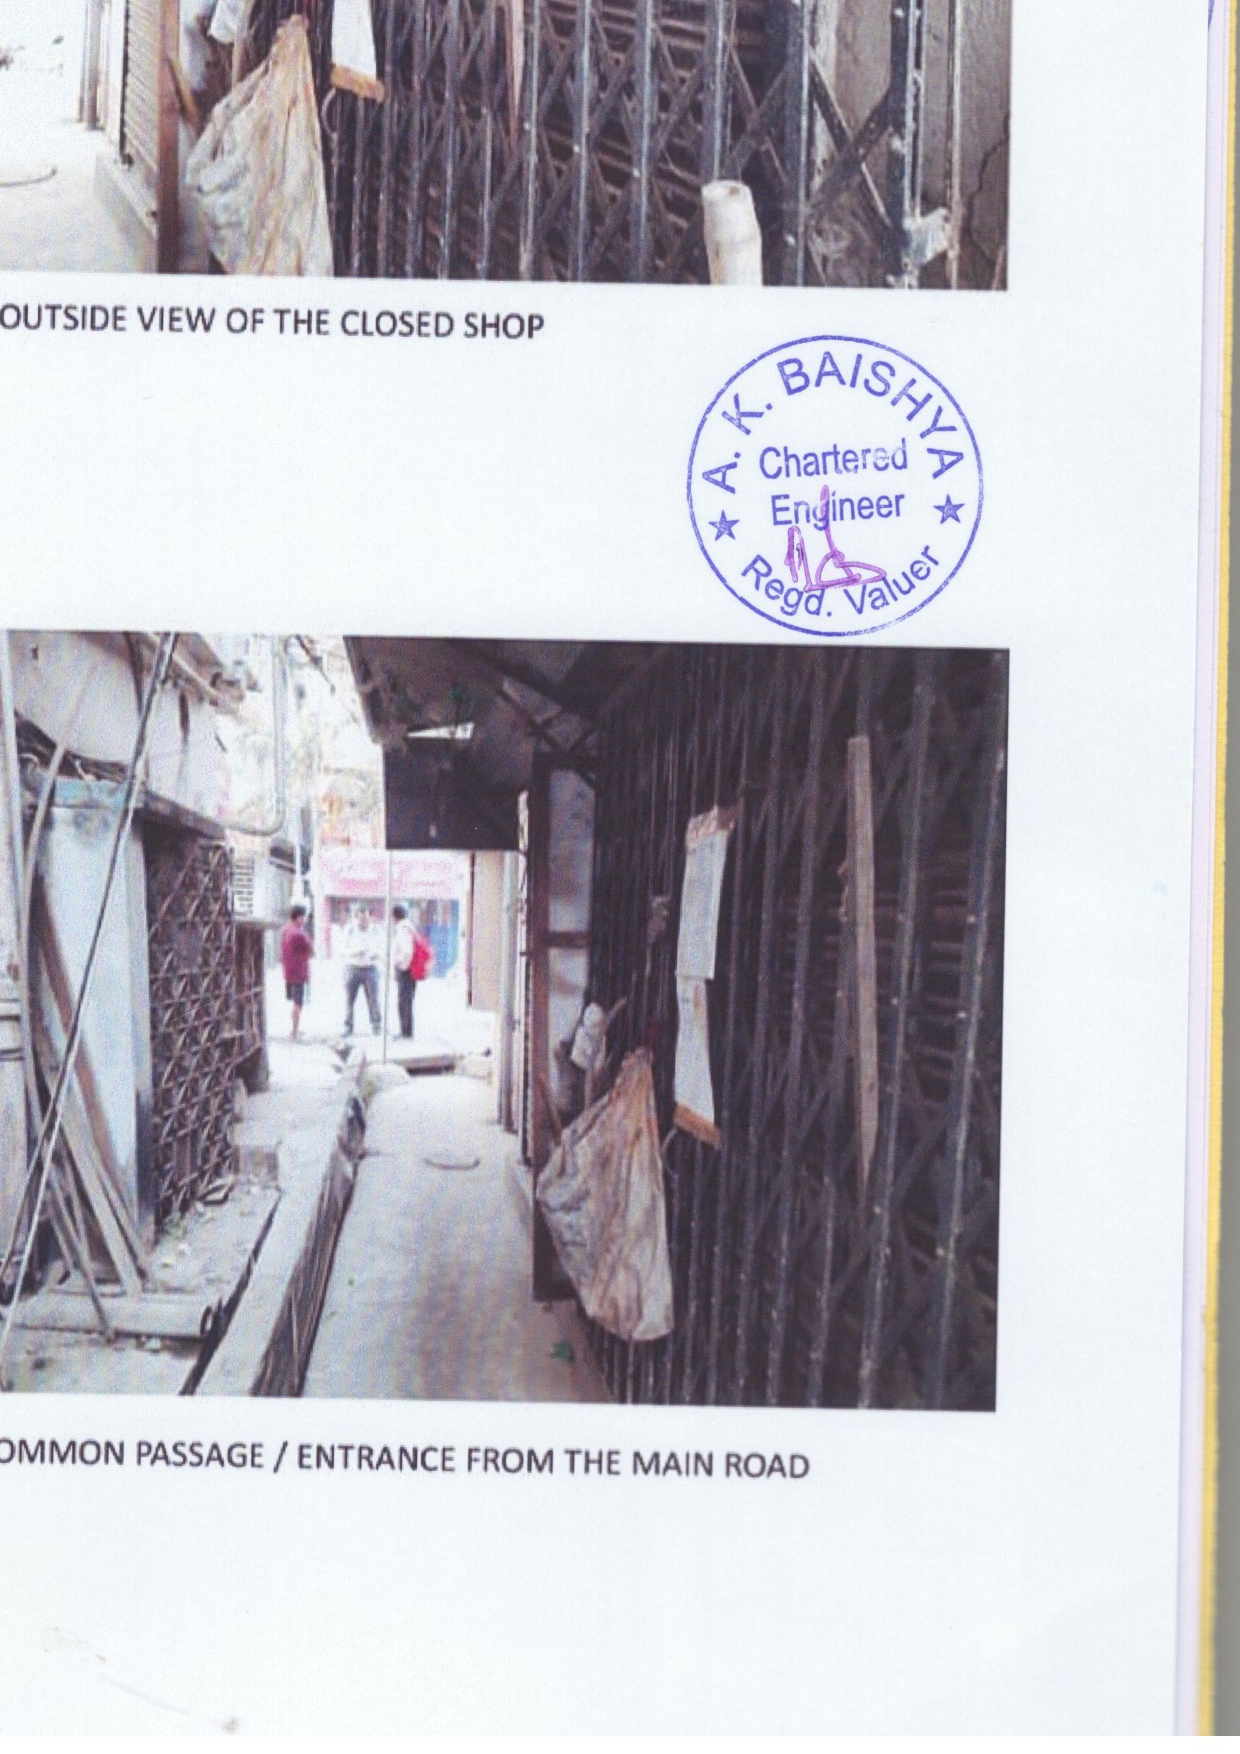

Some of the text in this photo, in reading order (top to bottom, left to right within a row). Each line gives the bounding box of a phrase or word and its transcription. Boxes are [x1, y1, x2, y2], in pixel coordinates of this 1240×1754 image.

[0, 303, 544, 339] OUTSIDE VIEW OF THE CLOSED SHOP
[702, 351, 965, 495] A. K. BAISHYA
[759, 438, 908, 479] Chartered
[771, 491, 905, 531] Engineer
[741, 544, 940, 617] Regd. Valuer
[137, 1441, 263, 1468] PASSAGE
[273, 1441, 288, 1473] /
[298, 1444, 454, 1472] ENTRANCE
[467, 1447, 554, 1474] FROM
[565, 1449, 620, 1475] THE
[633, 1451, 713, 1477] MAIN
[725, 1453, 810, 1479] ROAD
